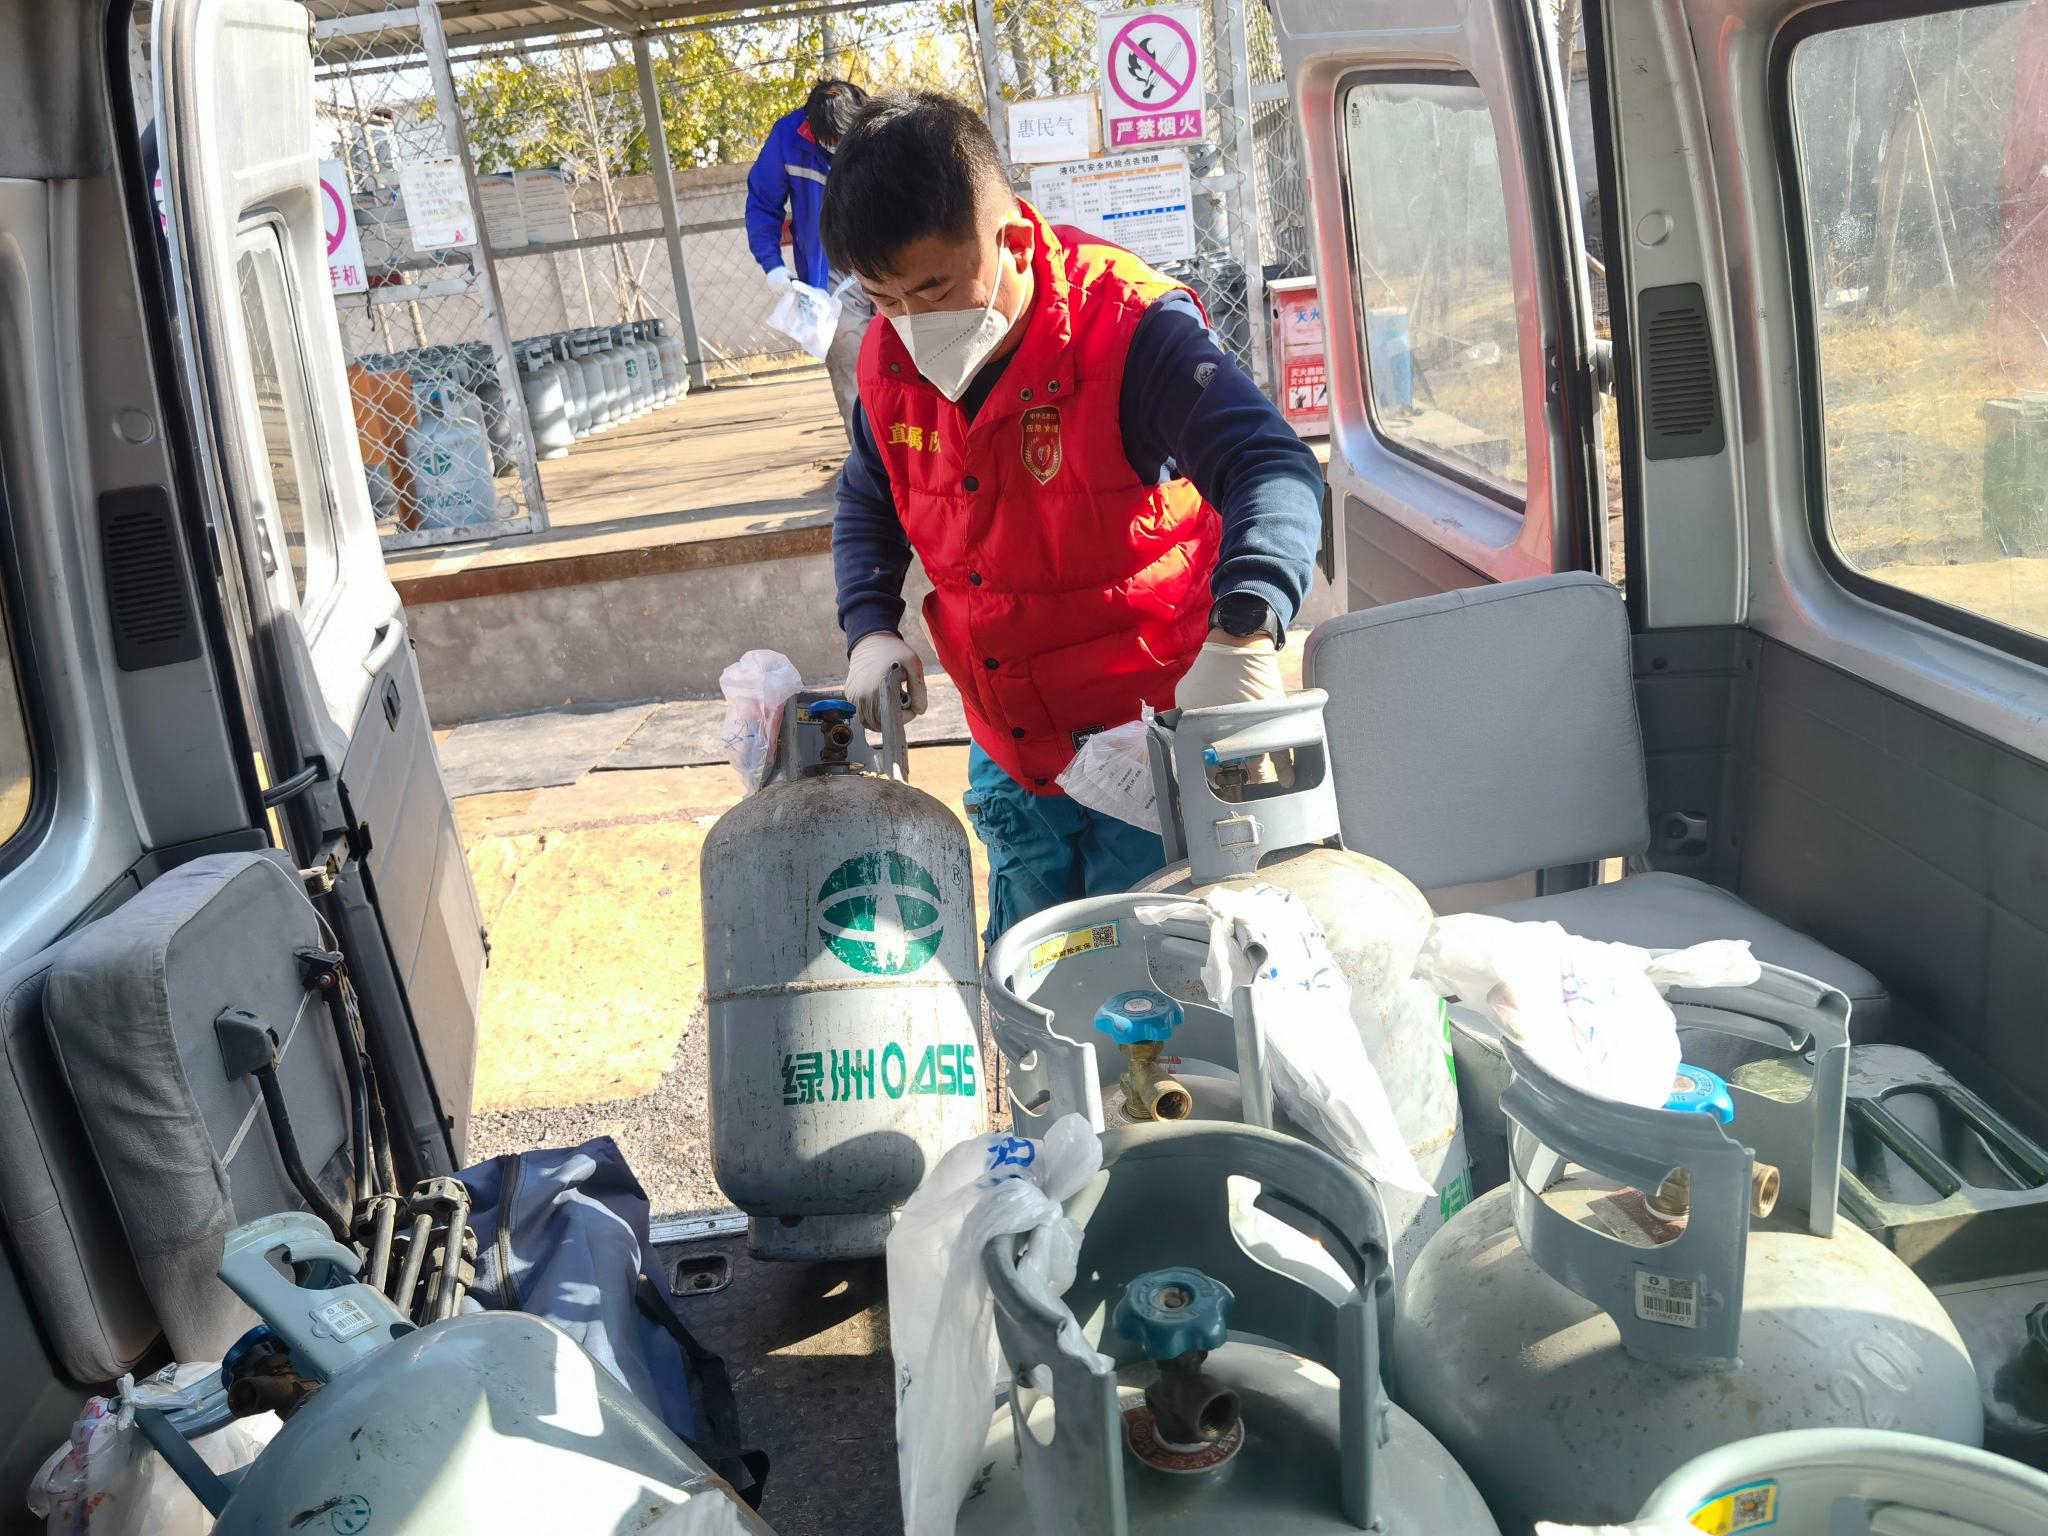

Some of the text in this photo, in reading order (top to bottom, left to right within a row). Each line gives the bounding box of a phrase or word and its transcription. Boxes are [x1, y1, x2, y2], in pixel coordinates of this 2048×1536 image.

[1017, 116, 1074, 139] 惠民气
[1116, 113, 1198, 142] 严禁烟火
[1059, 154, 1160, 176] 液化气安全风险点告知牌
